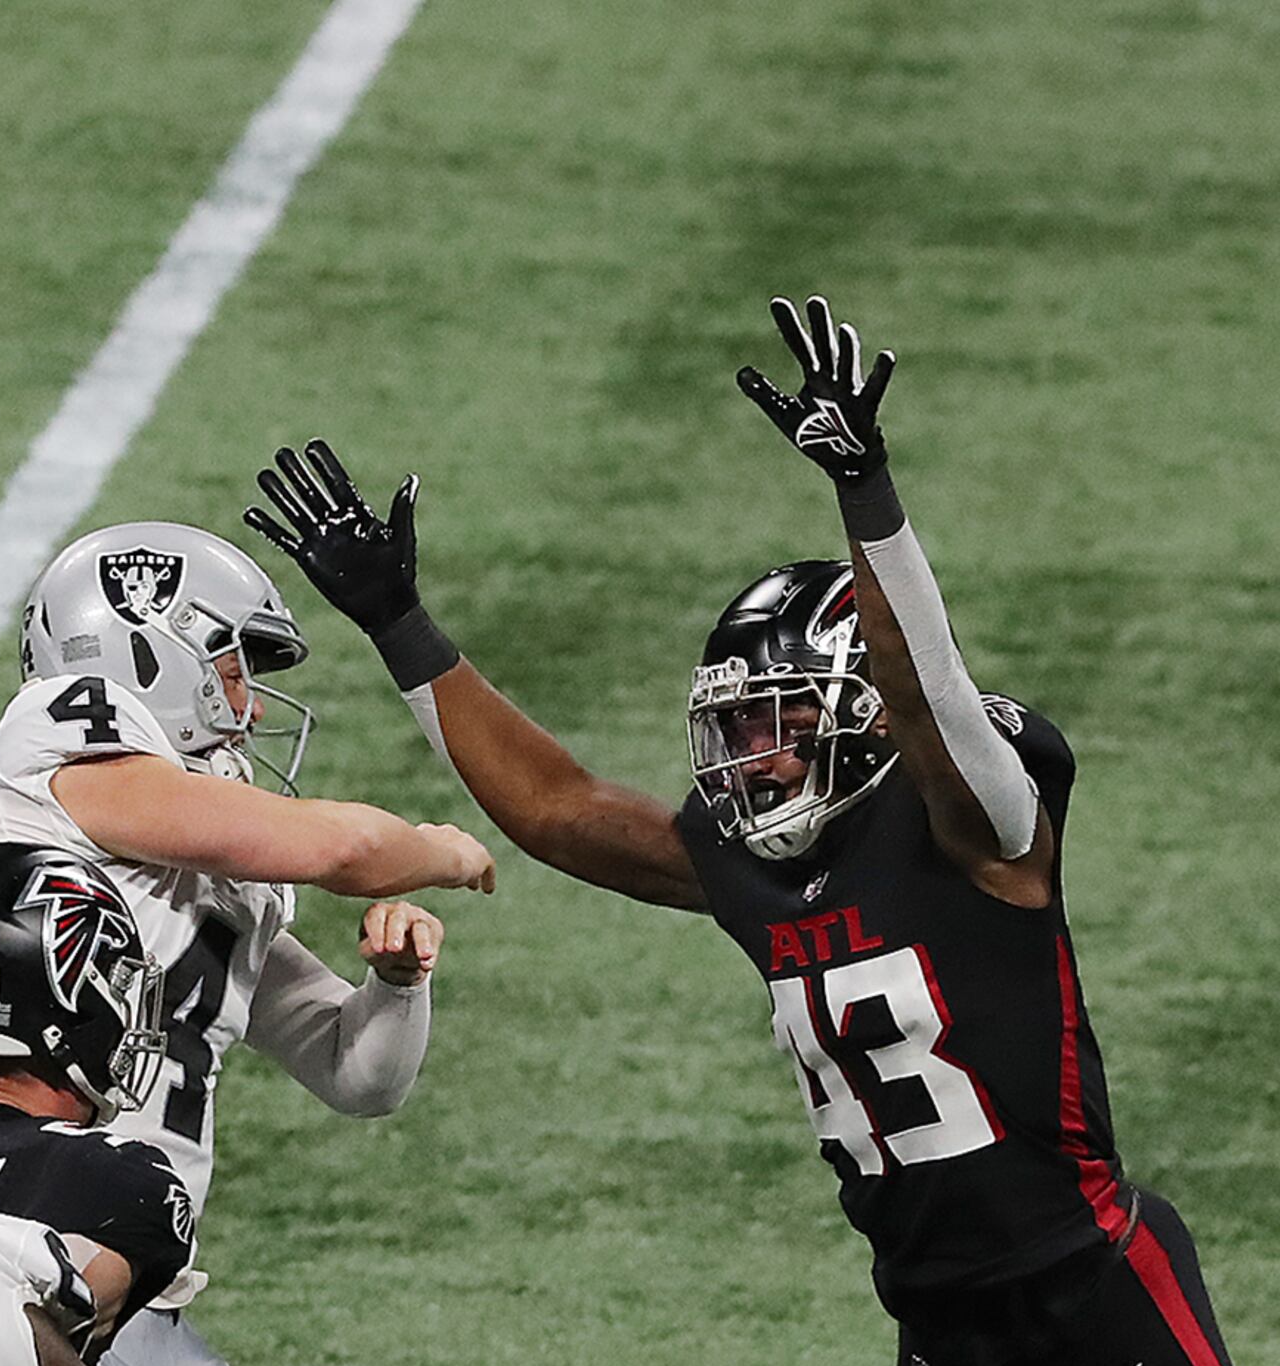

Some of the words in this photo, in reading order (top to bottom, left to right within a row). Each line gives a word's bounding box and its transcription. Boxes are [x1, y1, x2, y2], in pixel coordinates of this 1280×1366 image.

[107, 555, 176, 566] RAIDERS
[46, 676, 122, 745] 4
[765, 905, 884, 972] ATL
[769, 943, 1007, 1177] 43
